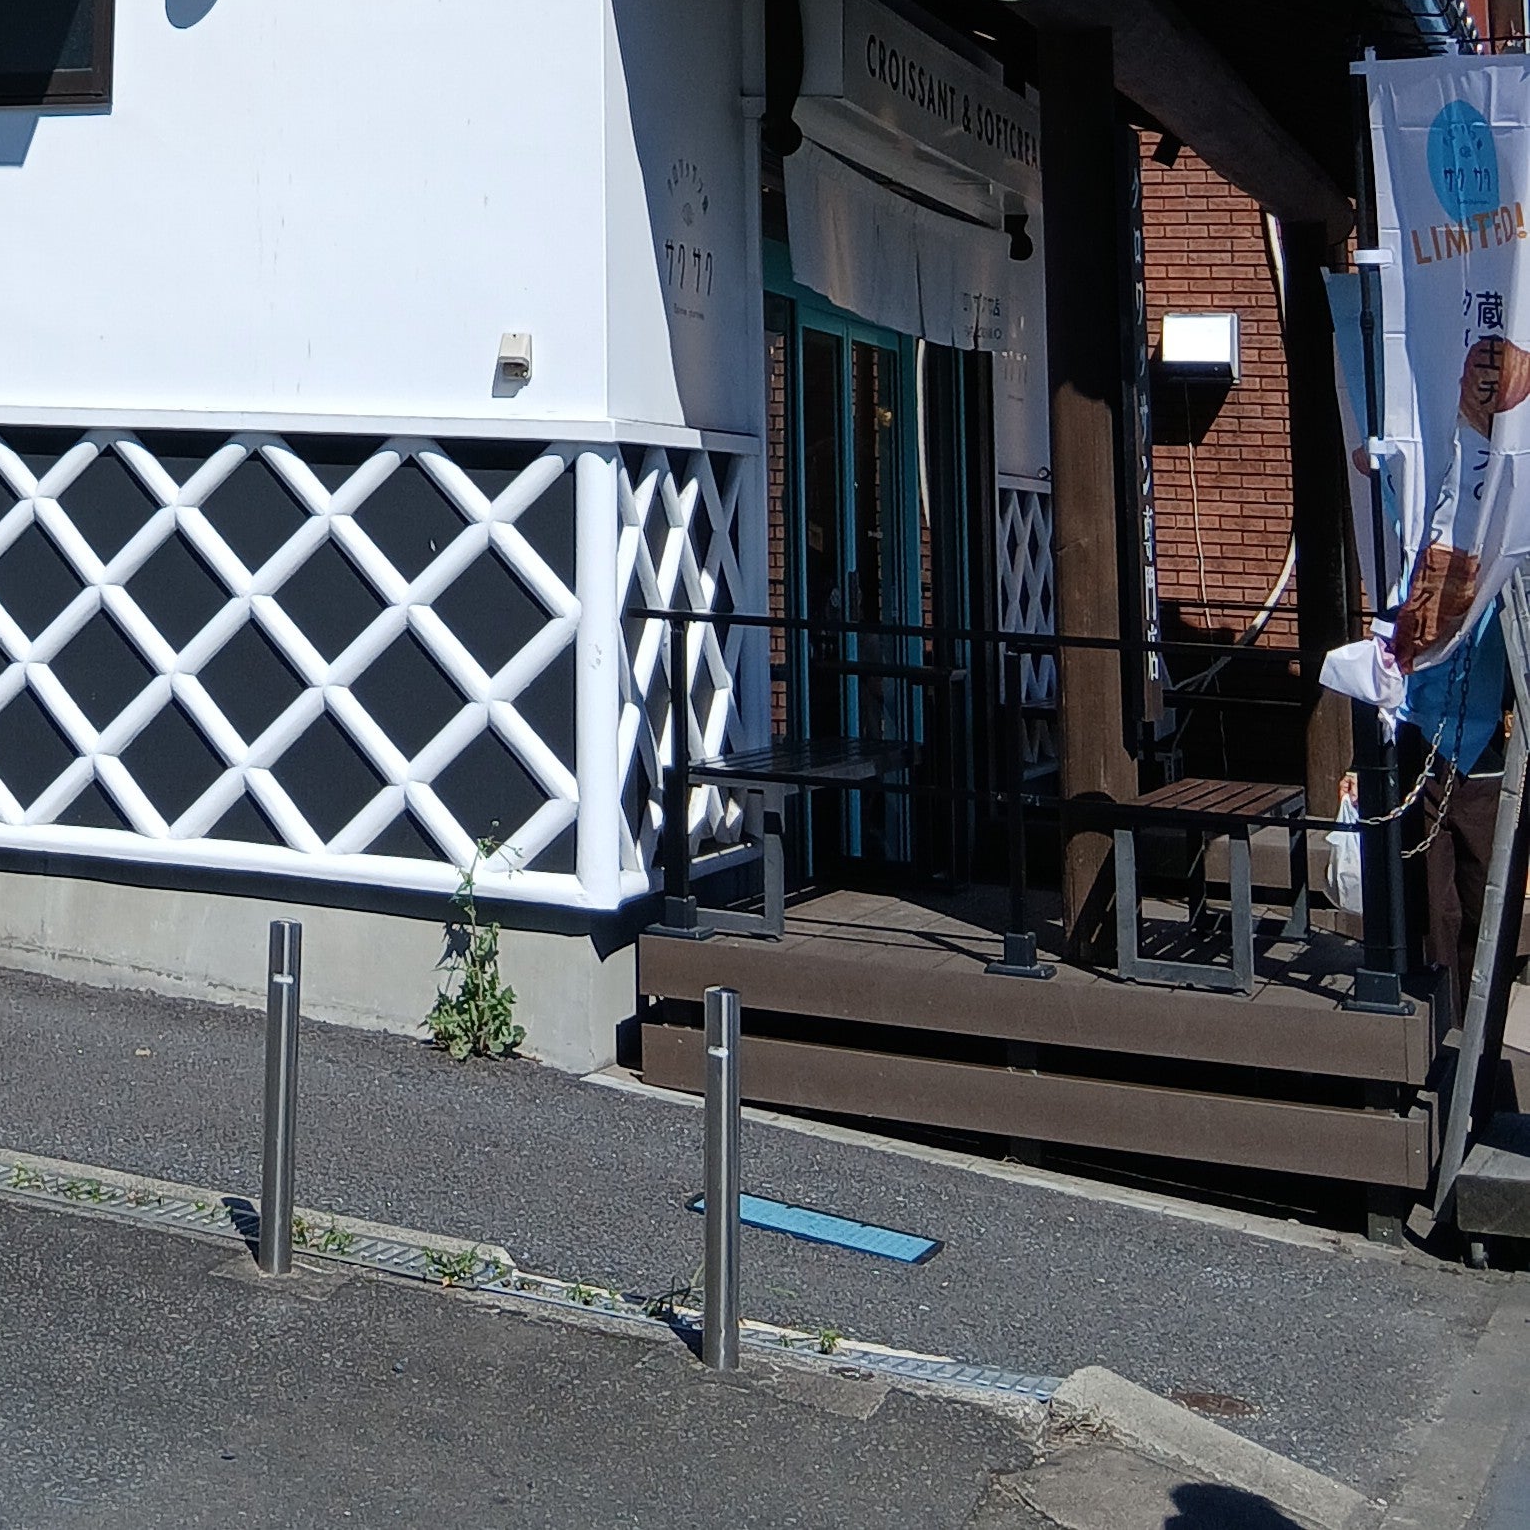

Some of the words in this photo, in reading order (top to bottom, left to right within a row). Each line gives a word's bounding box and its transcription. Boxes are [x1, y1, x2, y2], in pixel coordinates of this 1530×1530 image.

[866, 34, 956, 124] CROISSANT
[962, 94, 972, 134] &
[1411, 202, 1528, 265] LIMITED!
